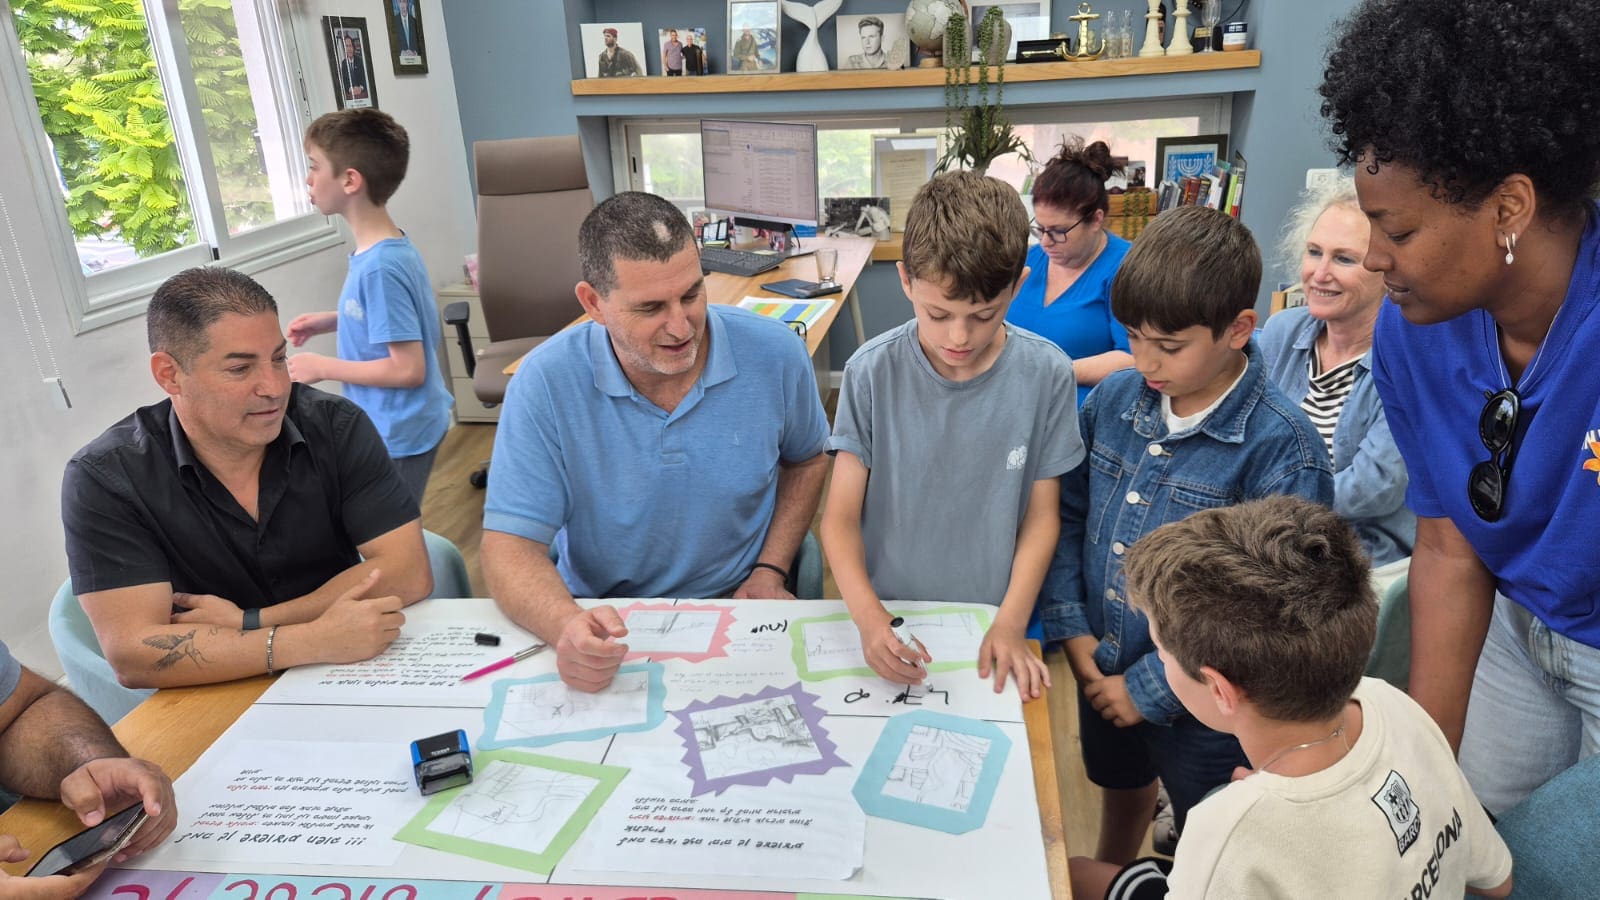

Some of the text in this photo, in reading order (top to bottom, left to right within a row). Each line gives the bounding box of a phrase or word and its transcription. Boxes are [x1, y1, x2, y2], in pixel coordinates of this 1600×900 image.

[174, 831, 215, 844] למה
[217, 830, 239, 842] גן
[239, 833, 303, 844] שעשועים
[306, 835, 342, 846] חשוב
[616, 836, 646, 846] למה
[650, 837, 678, 845] כדאי
[737, 838, 751, 847] גן
[755, 840, 804, 849] שעשועים
[1404, 807, 1463, 900] RCEONA
